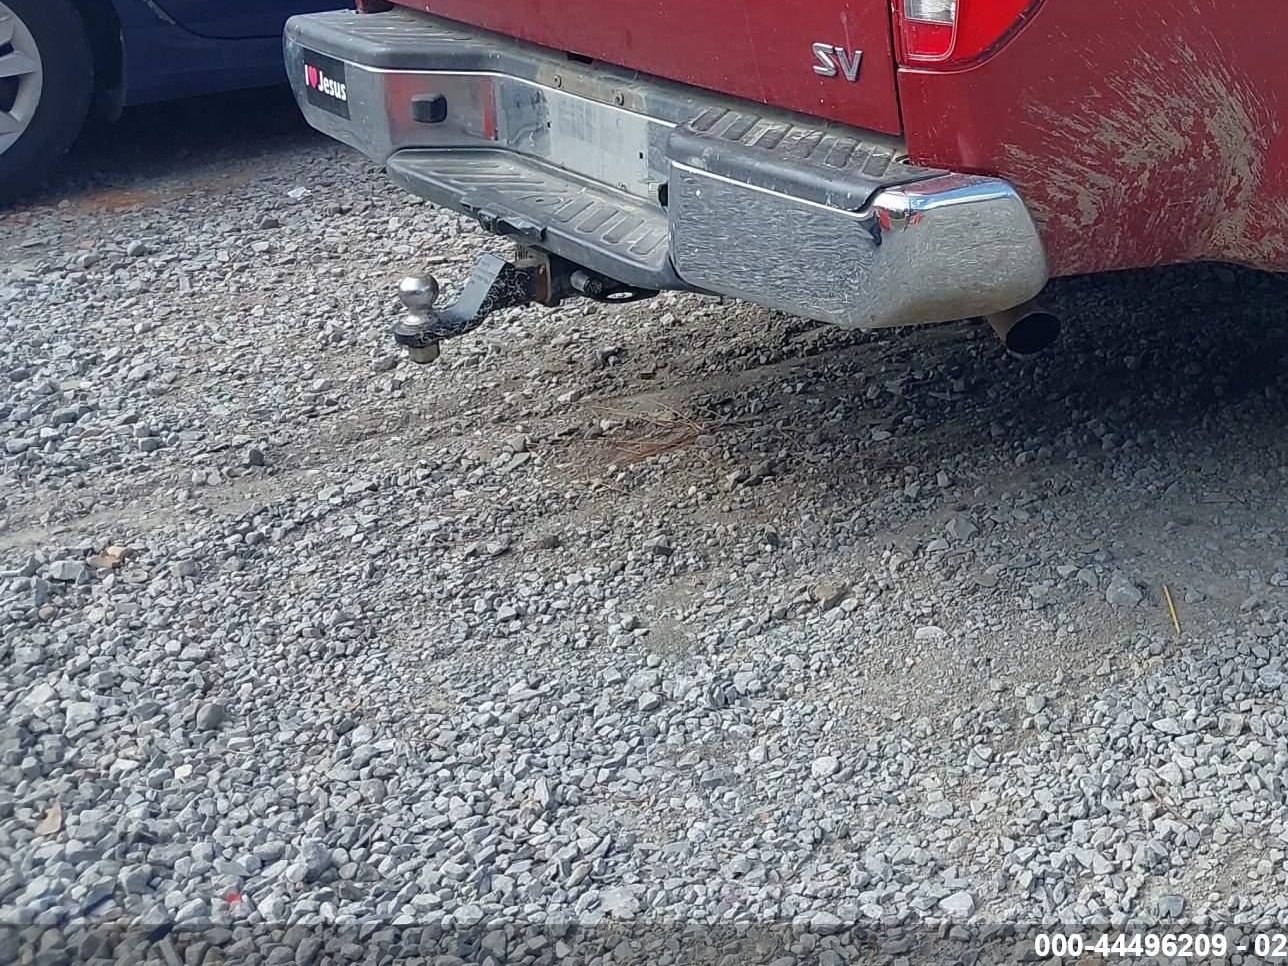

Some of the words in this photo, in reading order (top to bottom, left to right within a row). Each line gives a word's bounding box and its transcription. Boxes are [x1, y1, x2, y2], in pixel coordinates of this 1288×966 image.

[811, 42, 863, 82] SV
[304, 64, 310, 86] I
[318, 70, 347, 101] Jesus
